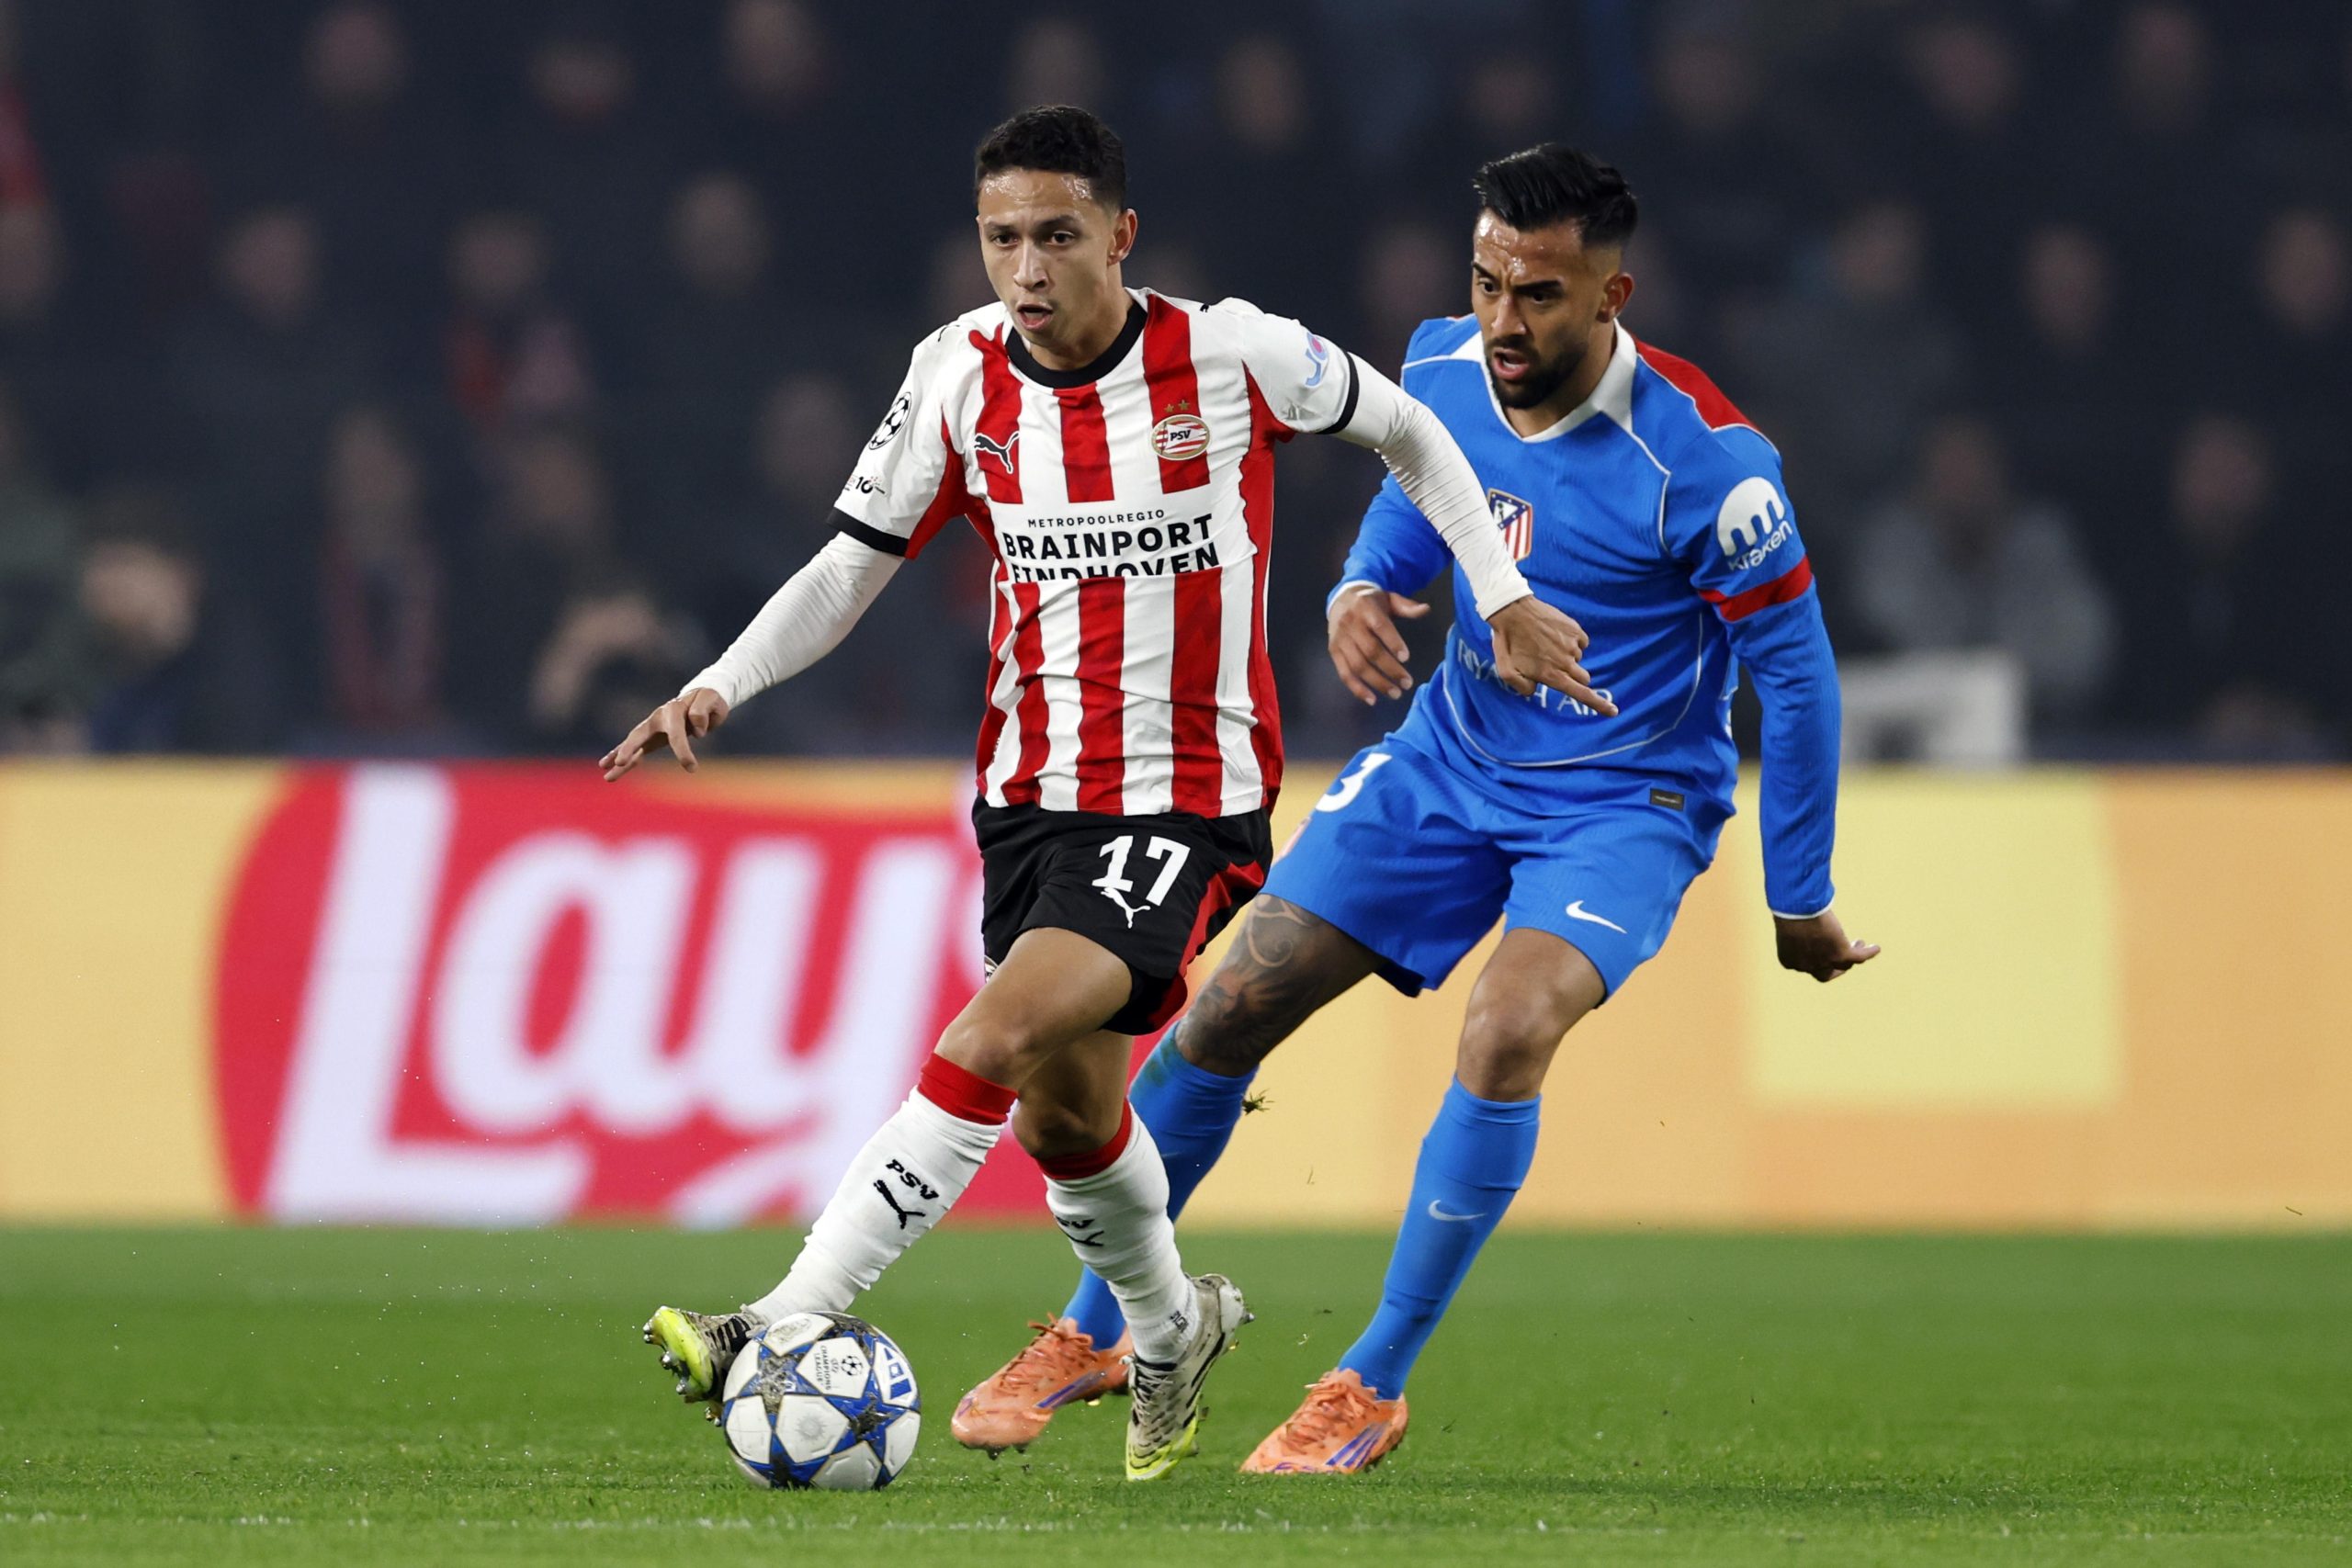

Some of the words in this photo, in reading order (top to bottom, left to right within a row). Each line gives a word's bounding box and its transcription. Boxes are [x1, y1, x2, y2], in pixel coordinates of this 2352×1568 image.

[1170, 429, 1192, 442] PSV
[1002, 513, 1213, 560] BRAINPORT
[1027, 509, 1165, 528] METROPOOLREGIO
[1727, 520, 1793, 571] kraken
[1457, 637, 1548, 709] RIYAH
[1092, 836, 1191, 906] 17
[260, 762, 985, 1226] Lay
[885, 1158, 940, 1201] PSV
[814, 1353, 823, 1382] LEAGUE
[820, 1345, 831, 1391] CHAMPIONS
